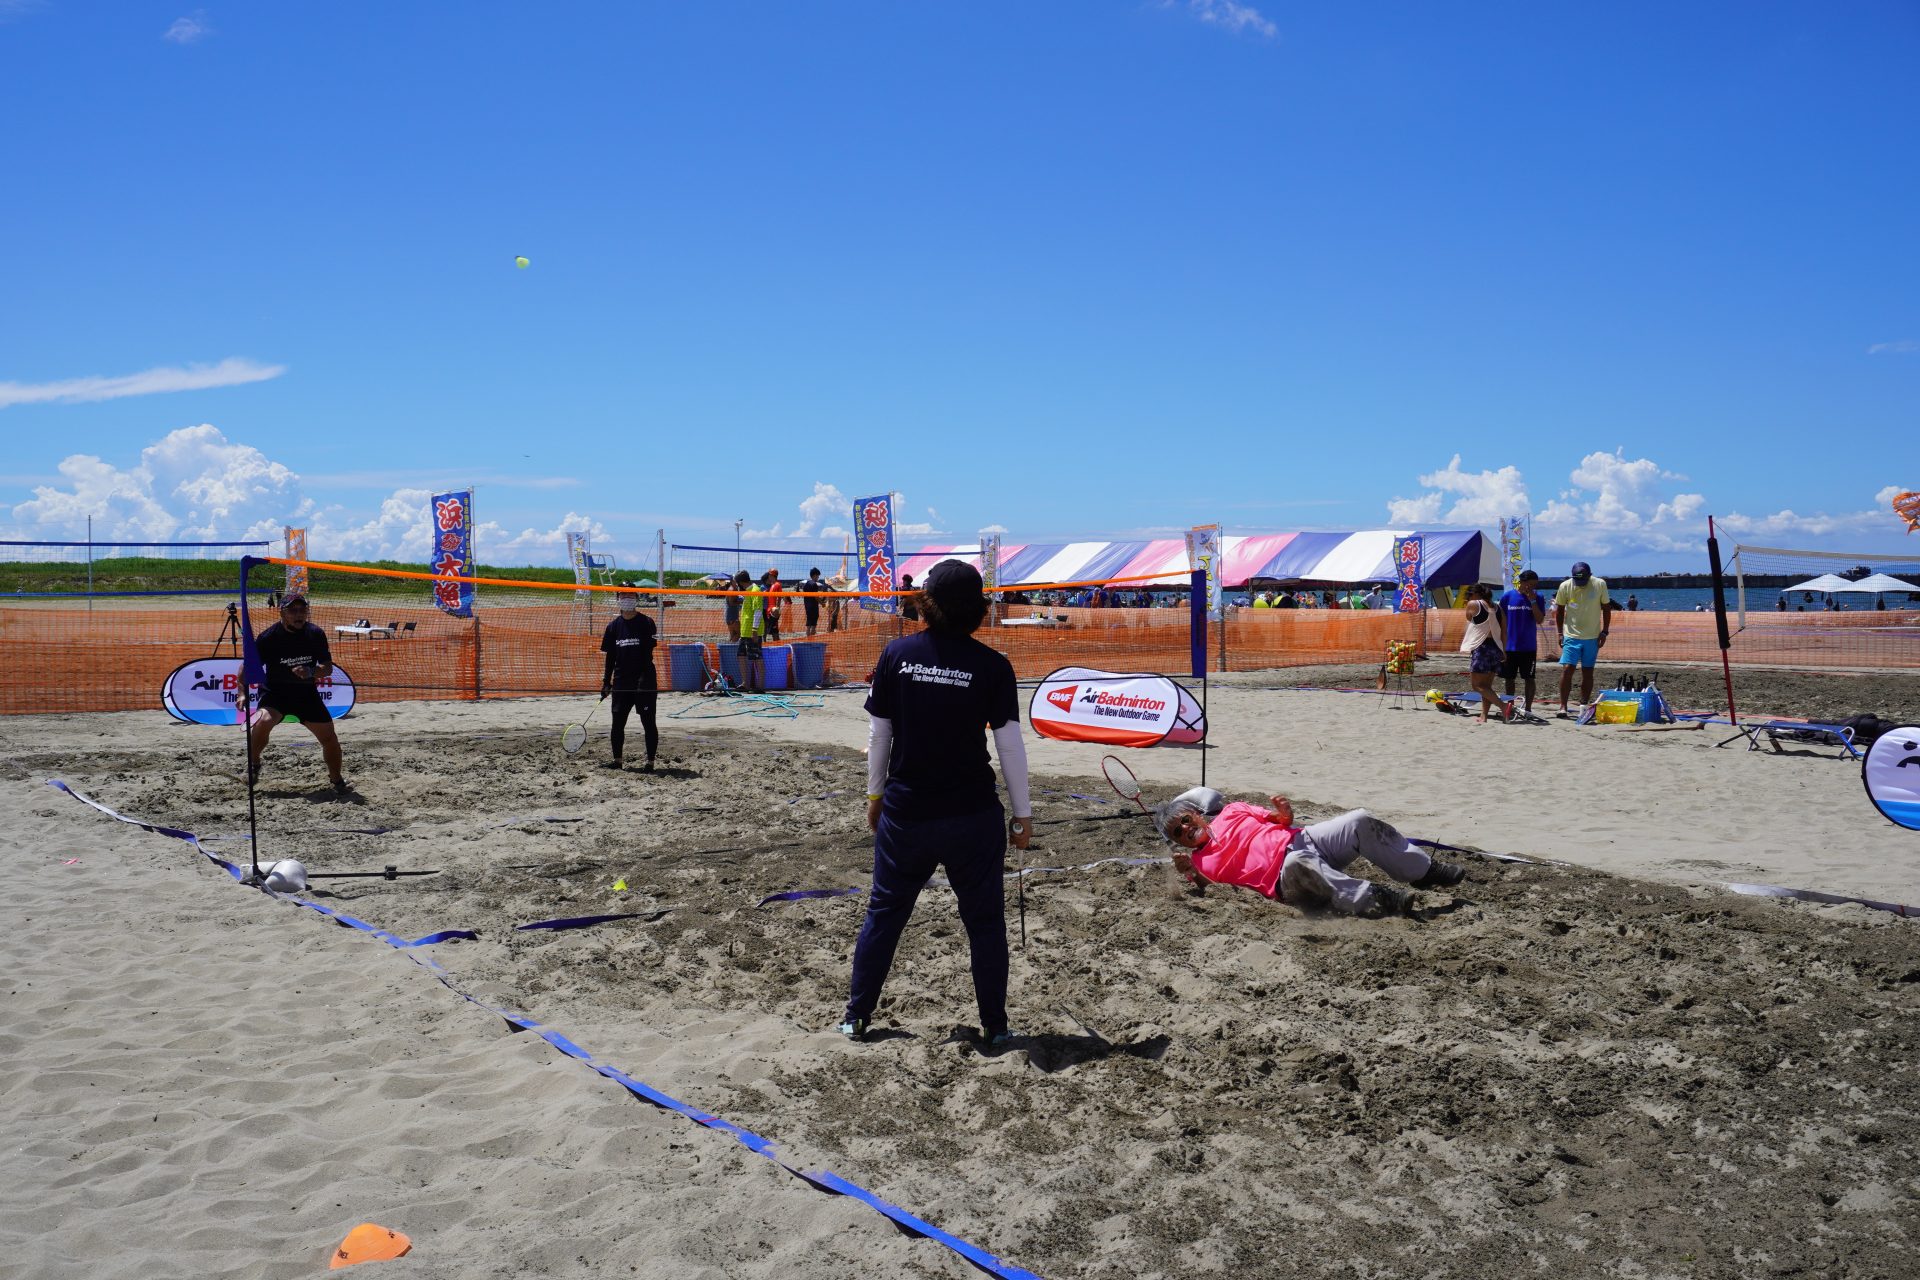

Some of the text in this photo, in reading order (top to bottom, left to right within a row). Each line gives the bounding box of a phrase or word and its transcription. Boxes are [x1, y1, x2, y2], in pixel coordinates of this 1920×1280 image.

[899, 661, 972, 680] AirBadminton
[1049, 692, 1073, 702] BWF
[1080, 687, 1166, 710] AirBadminton
[1094, 705, 1161, 721] The New Outdoor Game
